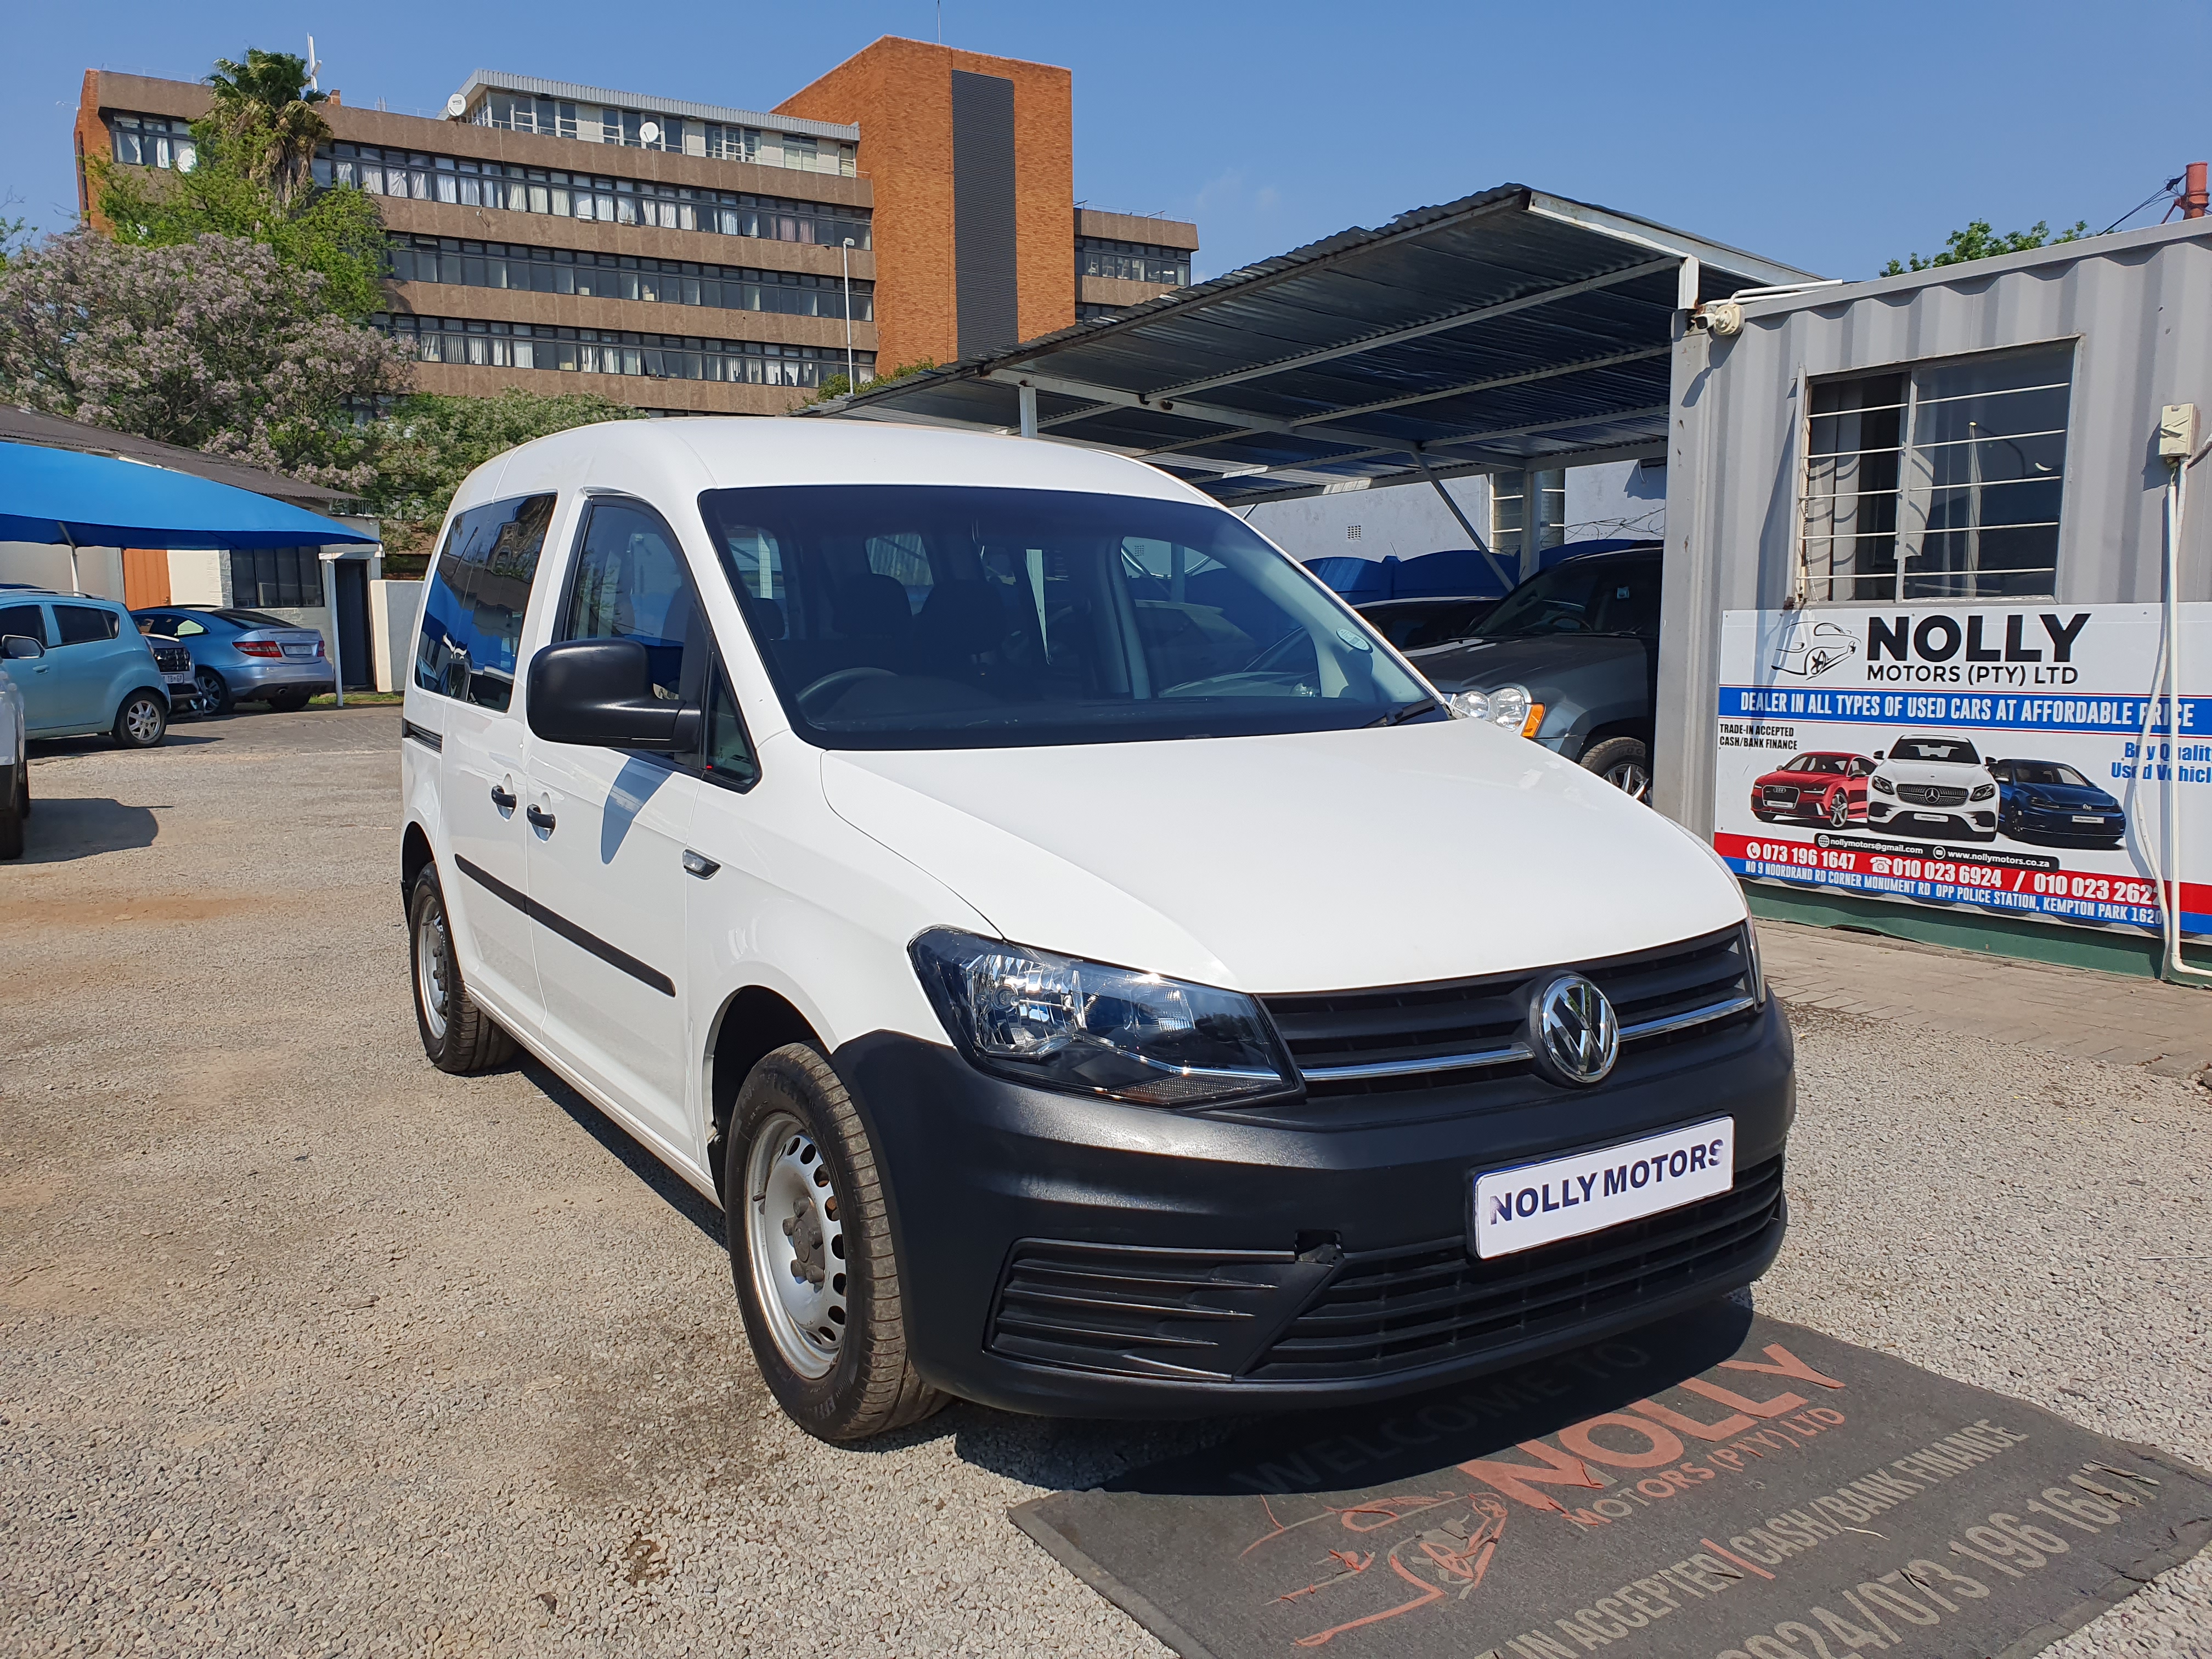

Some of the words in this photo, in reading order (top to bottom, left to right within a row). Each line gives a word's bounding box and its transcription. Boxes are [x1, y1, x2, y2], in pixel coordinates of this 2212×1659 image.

[1867, 613, 2092, 662] NOLLY
[1867, 664, 1960, 682] MOTORS
[1968, 665, 2026, 687] (PTY)
[2035, 666, 2078, 684] LTD
[1719, 724, 1754, 735] TRADE-IN
[1755, 725, 1794, 737] ACCEPTED
[1740, 692, 1787, 713] DEALER
[1791, 693, 1804, 713] IN
[1807, 694, 1832, 714] ALL
[1836, 695, 1880, 716] TYPES
[1884, 696, 1903, 717] OF
[1908, 697, 1946, 719] USED
[1951, 698, 1991, 721] CARS
[1995, 699, 2017, 721] AT
[2021, 700, 2134, 725] AFFORDABLE
[1719, 736, 1764, 748] CASH/BANK
[1765, 738, 1798, 750] FINANCE
[1763, 843, 1787, 861] 073
[1791, 847, 1818, 866] 196
[1821, 851, 1855, 870] 1647
[1830, 837, 1923, 855] nollymotors@gmail.com
[1948, 849, 2050, 868] www.nollymotors.co.za
[1745, 860, 1756, 874] NO
[1757, 862, 1763, 874] 9
[1765, 862, 1812, 882] NOORDRAND
[1814, 870, 1826, 883] RD
[1828, 871, 1861, 887] CORNER
[1864, 875, 1916, 893] MONUMENT
[1918, 882, 1931, 895] RD
[1936, 884, 1954, 899] OPP
[1957, 886, 1990, 904] POLICE
[1994, 890, 2040, 911] STATION,
[2043, 897, 2095, 917] KEMPTON
[2098, 902, 2128, 921] PARK
[2131, 907, 2162, 924] 1620
[1893, 858, 1921, 878] 010
[1925, 861, 1955, 882] 023
[1959, 866, 2001, 888] 6924
[2034, 873, 2068, 895] 010
[2074, 878, 2109, 900] 023
[1489, 1172, 1598, 1225] NOLLY
[1603, 1138, 1724, 1197] MOTORS
[1229, 1372, 1572, 1495] WELCOME
[1555, 1341, 1650, 1379] TO
[1457, 1342, 1846, 1512] NOLLY
[1561, 1462, 1716, 1531] MOTORS
[1792, 1407, 1846, 1436] LTD
[1729, 1467, 1926, 1564] CASH/BANK
[1892, 1419, 2030, 1482] FINANCE
[1948, 1511, 2071, 1578] 196
